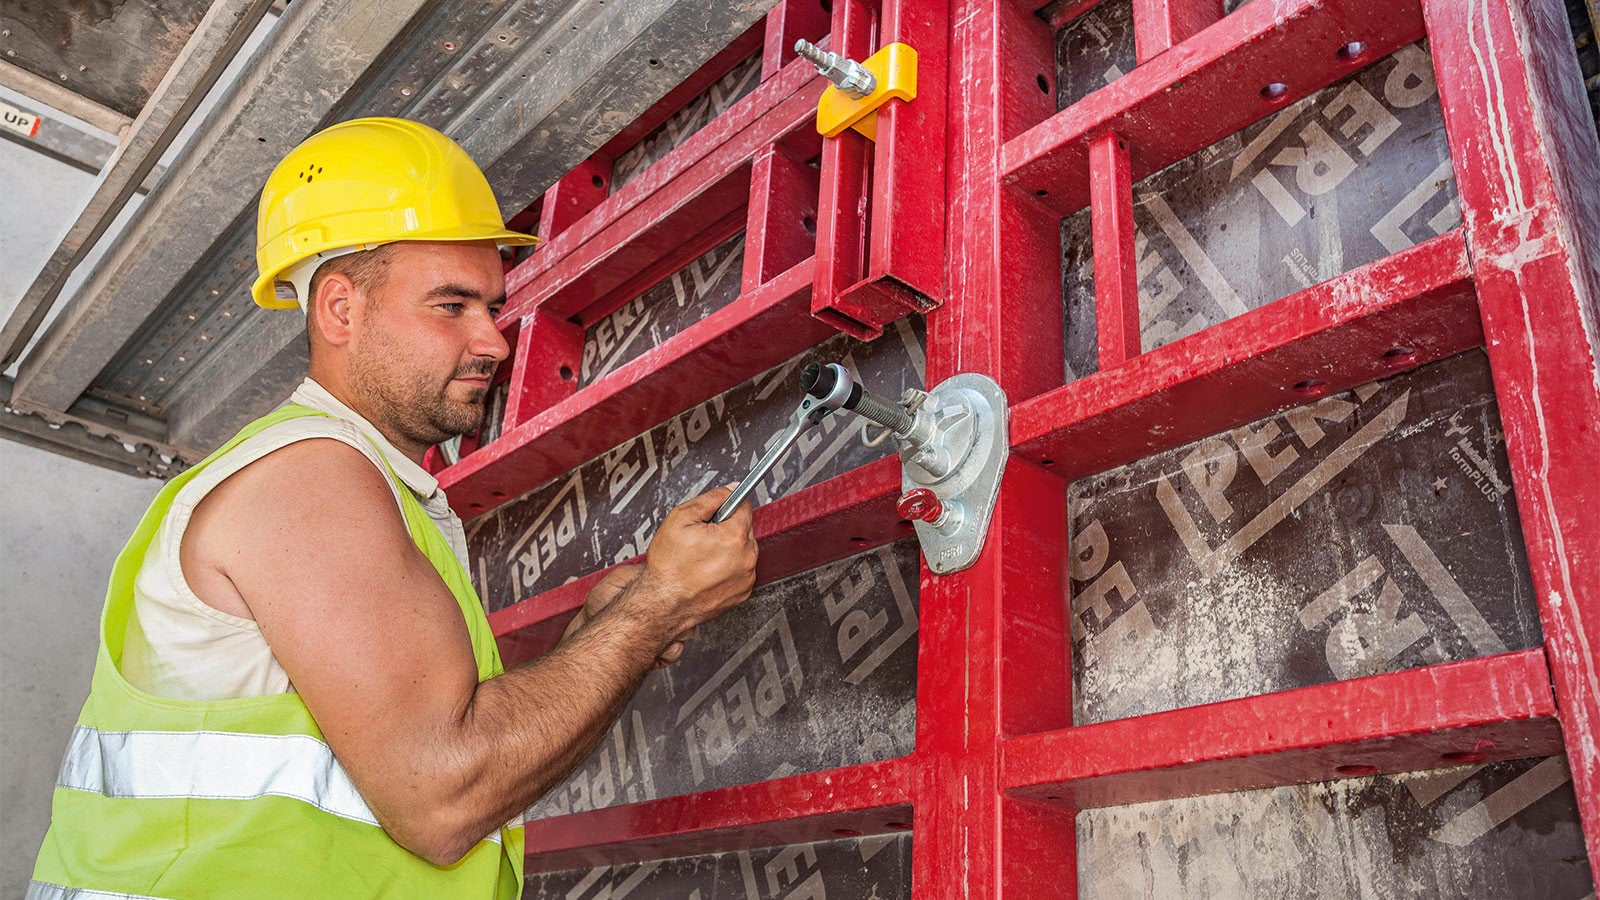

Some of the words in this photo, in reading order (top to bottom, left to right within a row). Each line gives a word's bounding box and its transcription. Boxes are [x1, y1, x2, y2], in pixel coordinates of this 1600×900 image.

[4, 111, 29, 126] UP
[1251, 43, 1437, 228] PERI
[1448, 446, 1499, 503] formPLUS
[511, 499, 576, 604] PERI
[815, 558, 888, 664] PE
[684, 648, 787, 787] PERI
